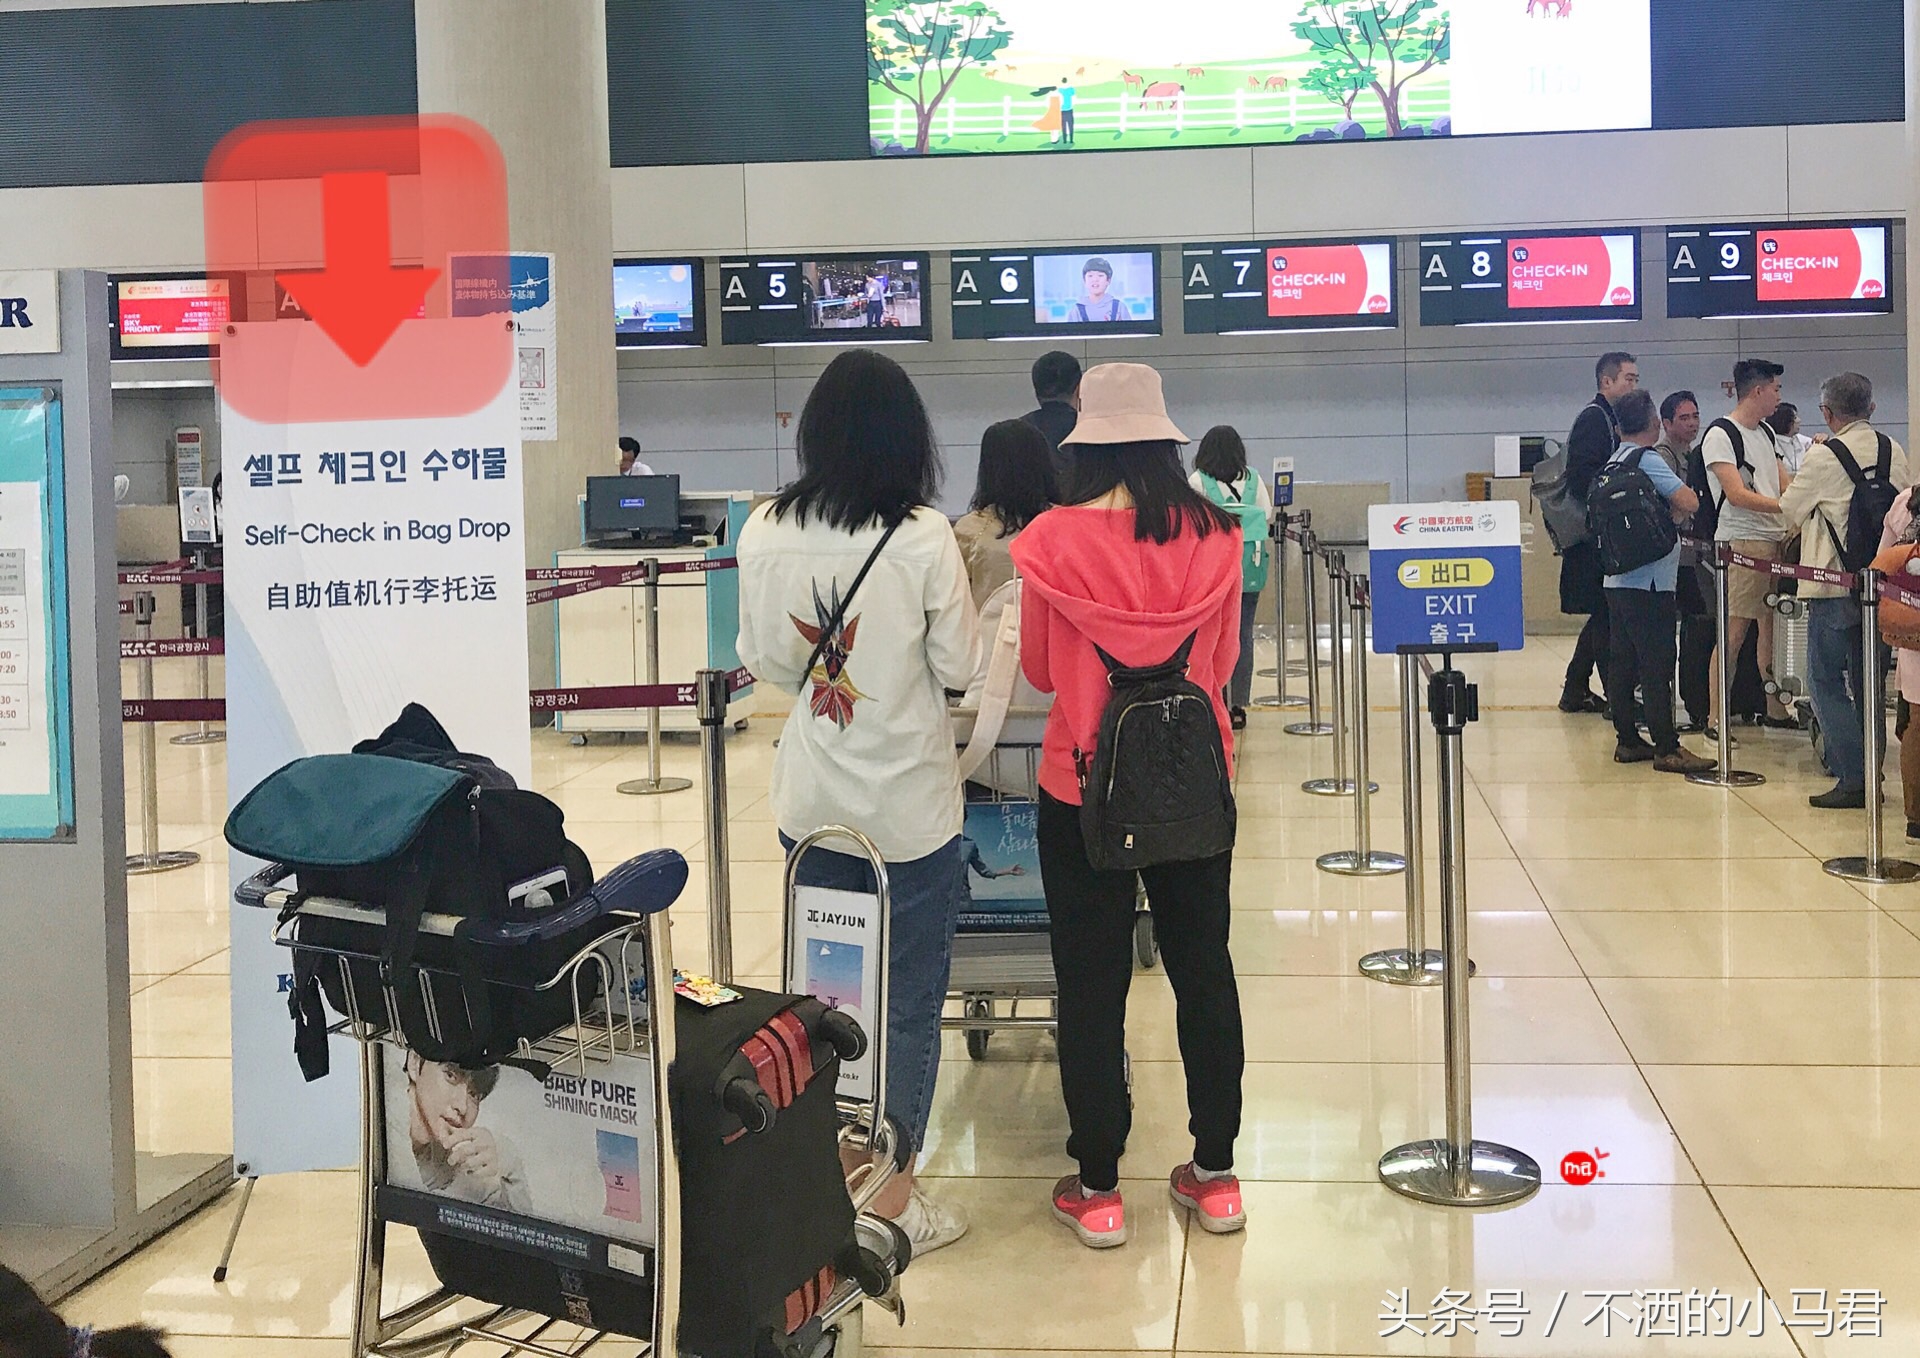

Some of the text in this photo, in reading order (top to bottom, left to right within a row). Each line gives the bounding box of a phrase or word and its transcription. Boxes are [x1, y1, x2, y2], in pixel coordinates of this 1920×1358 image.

[1425, 251, 1491, 278] A 8
[1673, 242, 1740, 270] A 9
[1761, 256, 1839, 271] CHECK-IN
[1188, 260, 1251, 287] A 7
[1512, 264, 1588, 278] CHECK-IN
[1761, 272, 1793, 283] 체크인
[725, 273, 787, 299] A 5
[956, 267, 1019, 293] A 6
[1271, 273, 1346, 288] CHECK-IN
[1512, 279, 1543, 291] 체크인
[1272, 288, 1302, 299] 체크인
[243, 447, 507, 487] 셀프 체크인 수하물
[1418, 516, 1473, 526] 中國東方航空
[1442, 525, 1474, 533] EASTERN
[245, 518, 511, 546] Self-Check in Bag Drop
[126, 574, 149, 583] KAC
[536, 569, 560, 579] KAC
[1431, 562, 1470, 584] 出口
[267, 575, 497, 611] 自助值机行李托运
[1425, 594, 1477, 616] EXIT
[121, 642, 156, 656] KAC
[820, 911, 866, 928] JAYJUN
[838, 1072, 859, 1081] .co.kr
[543, 1076, 637, 1107] BABY PURE
[543, 1092, 637, 1126] SHINING MASK
